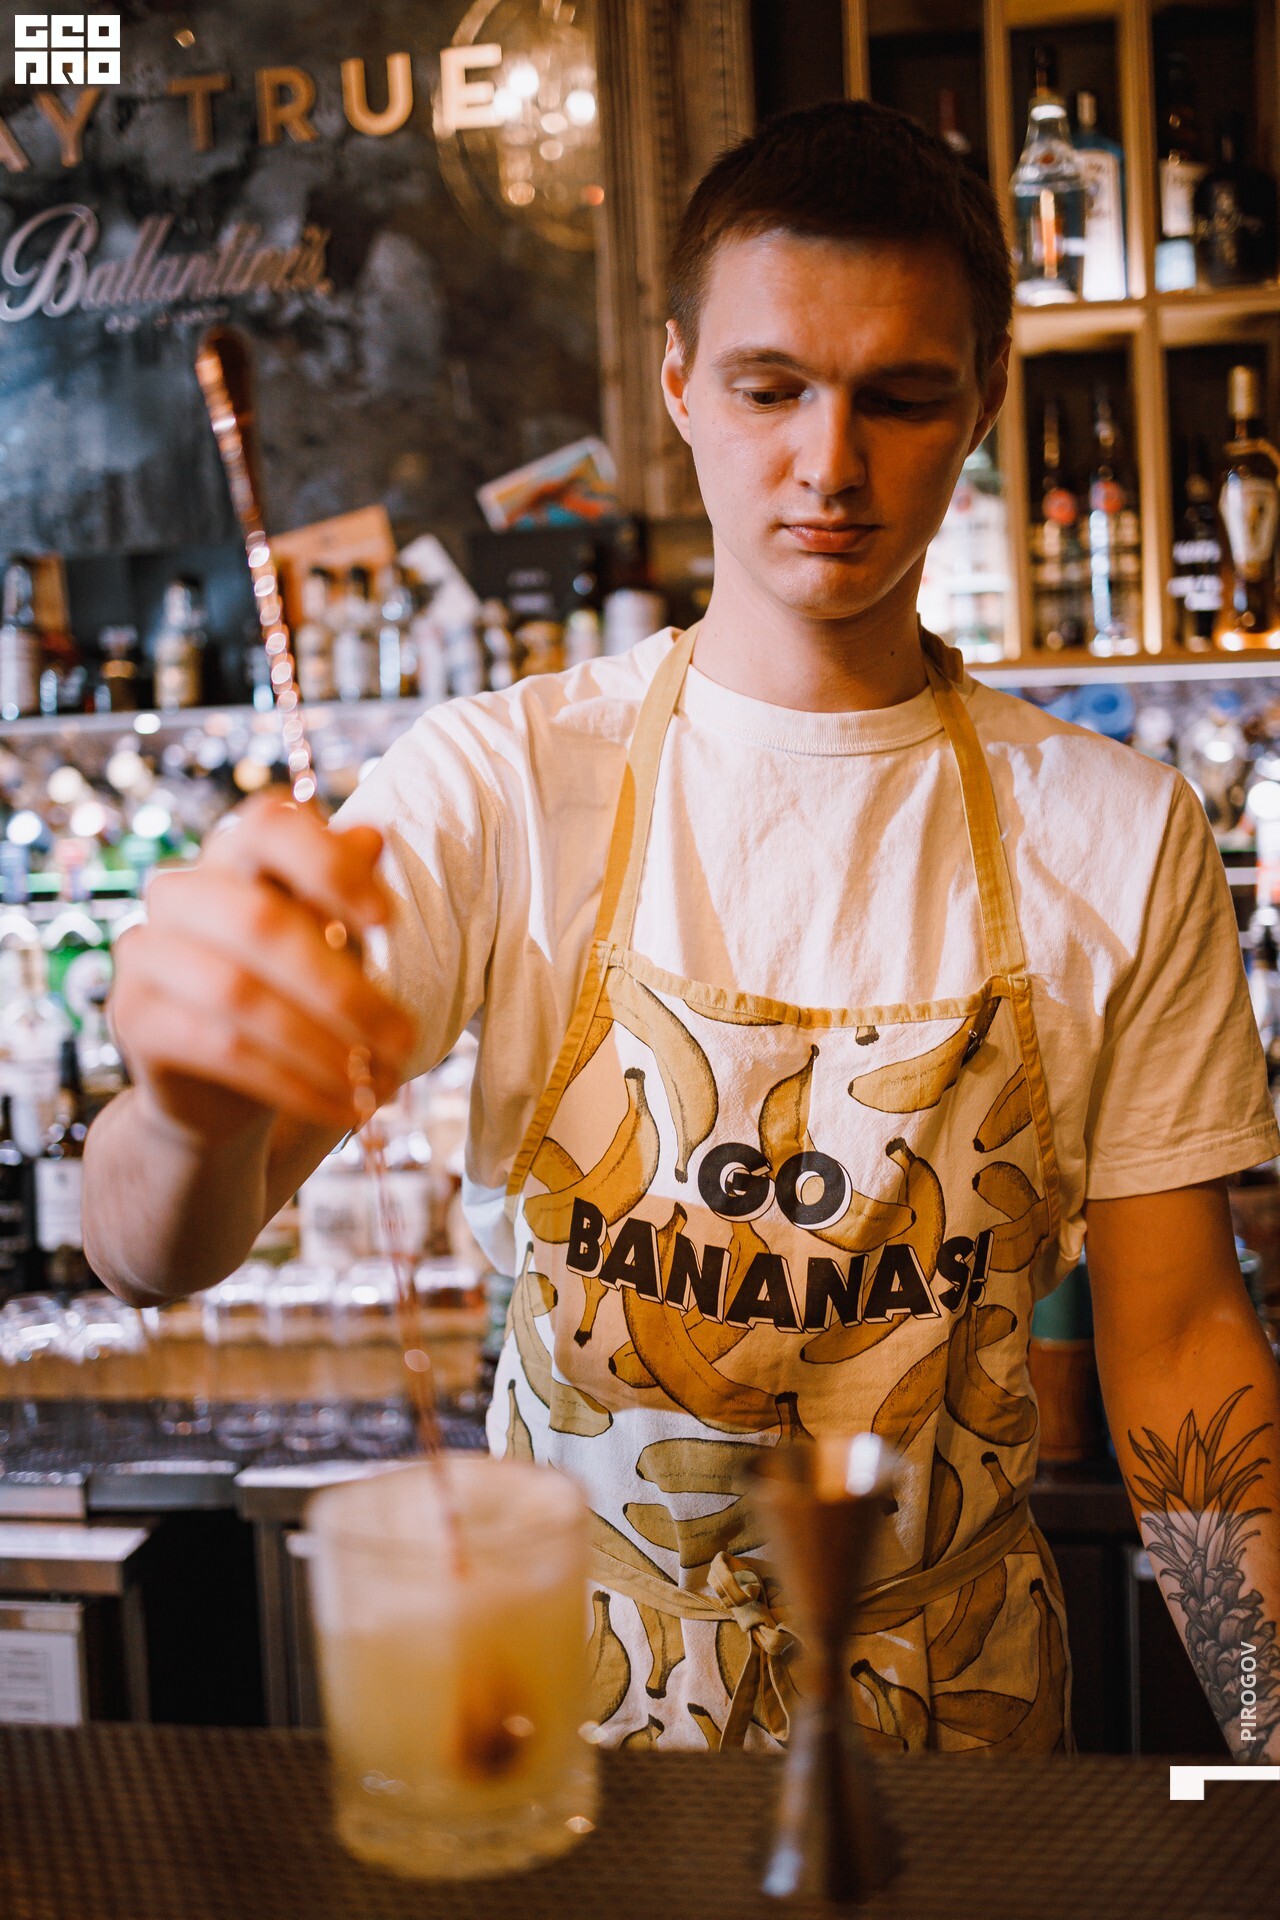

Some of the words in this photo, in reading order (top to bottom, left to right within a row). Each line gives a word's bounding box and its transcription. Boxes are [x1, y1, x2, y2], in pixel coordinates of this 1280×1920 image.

[168, 43, 503, 152] TRUE
[697, 1142, 852, 1230] GO
[566, 1197, 994, 1334] BANANAS!
